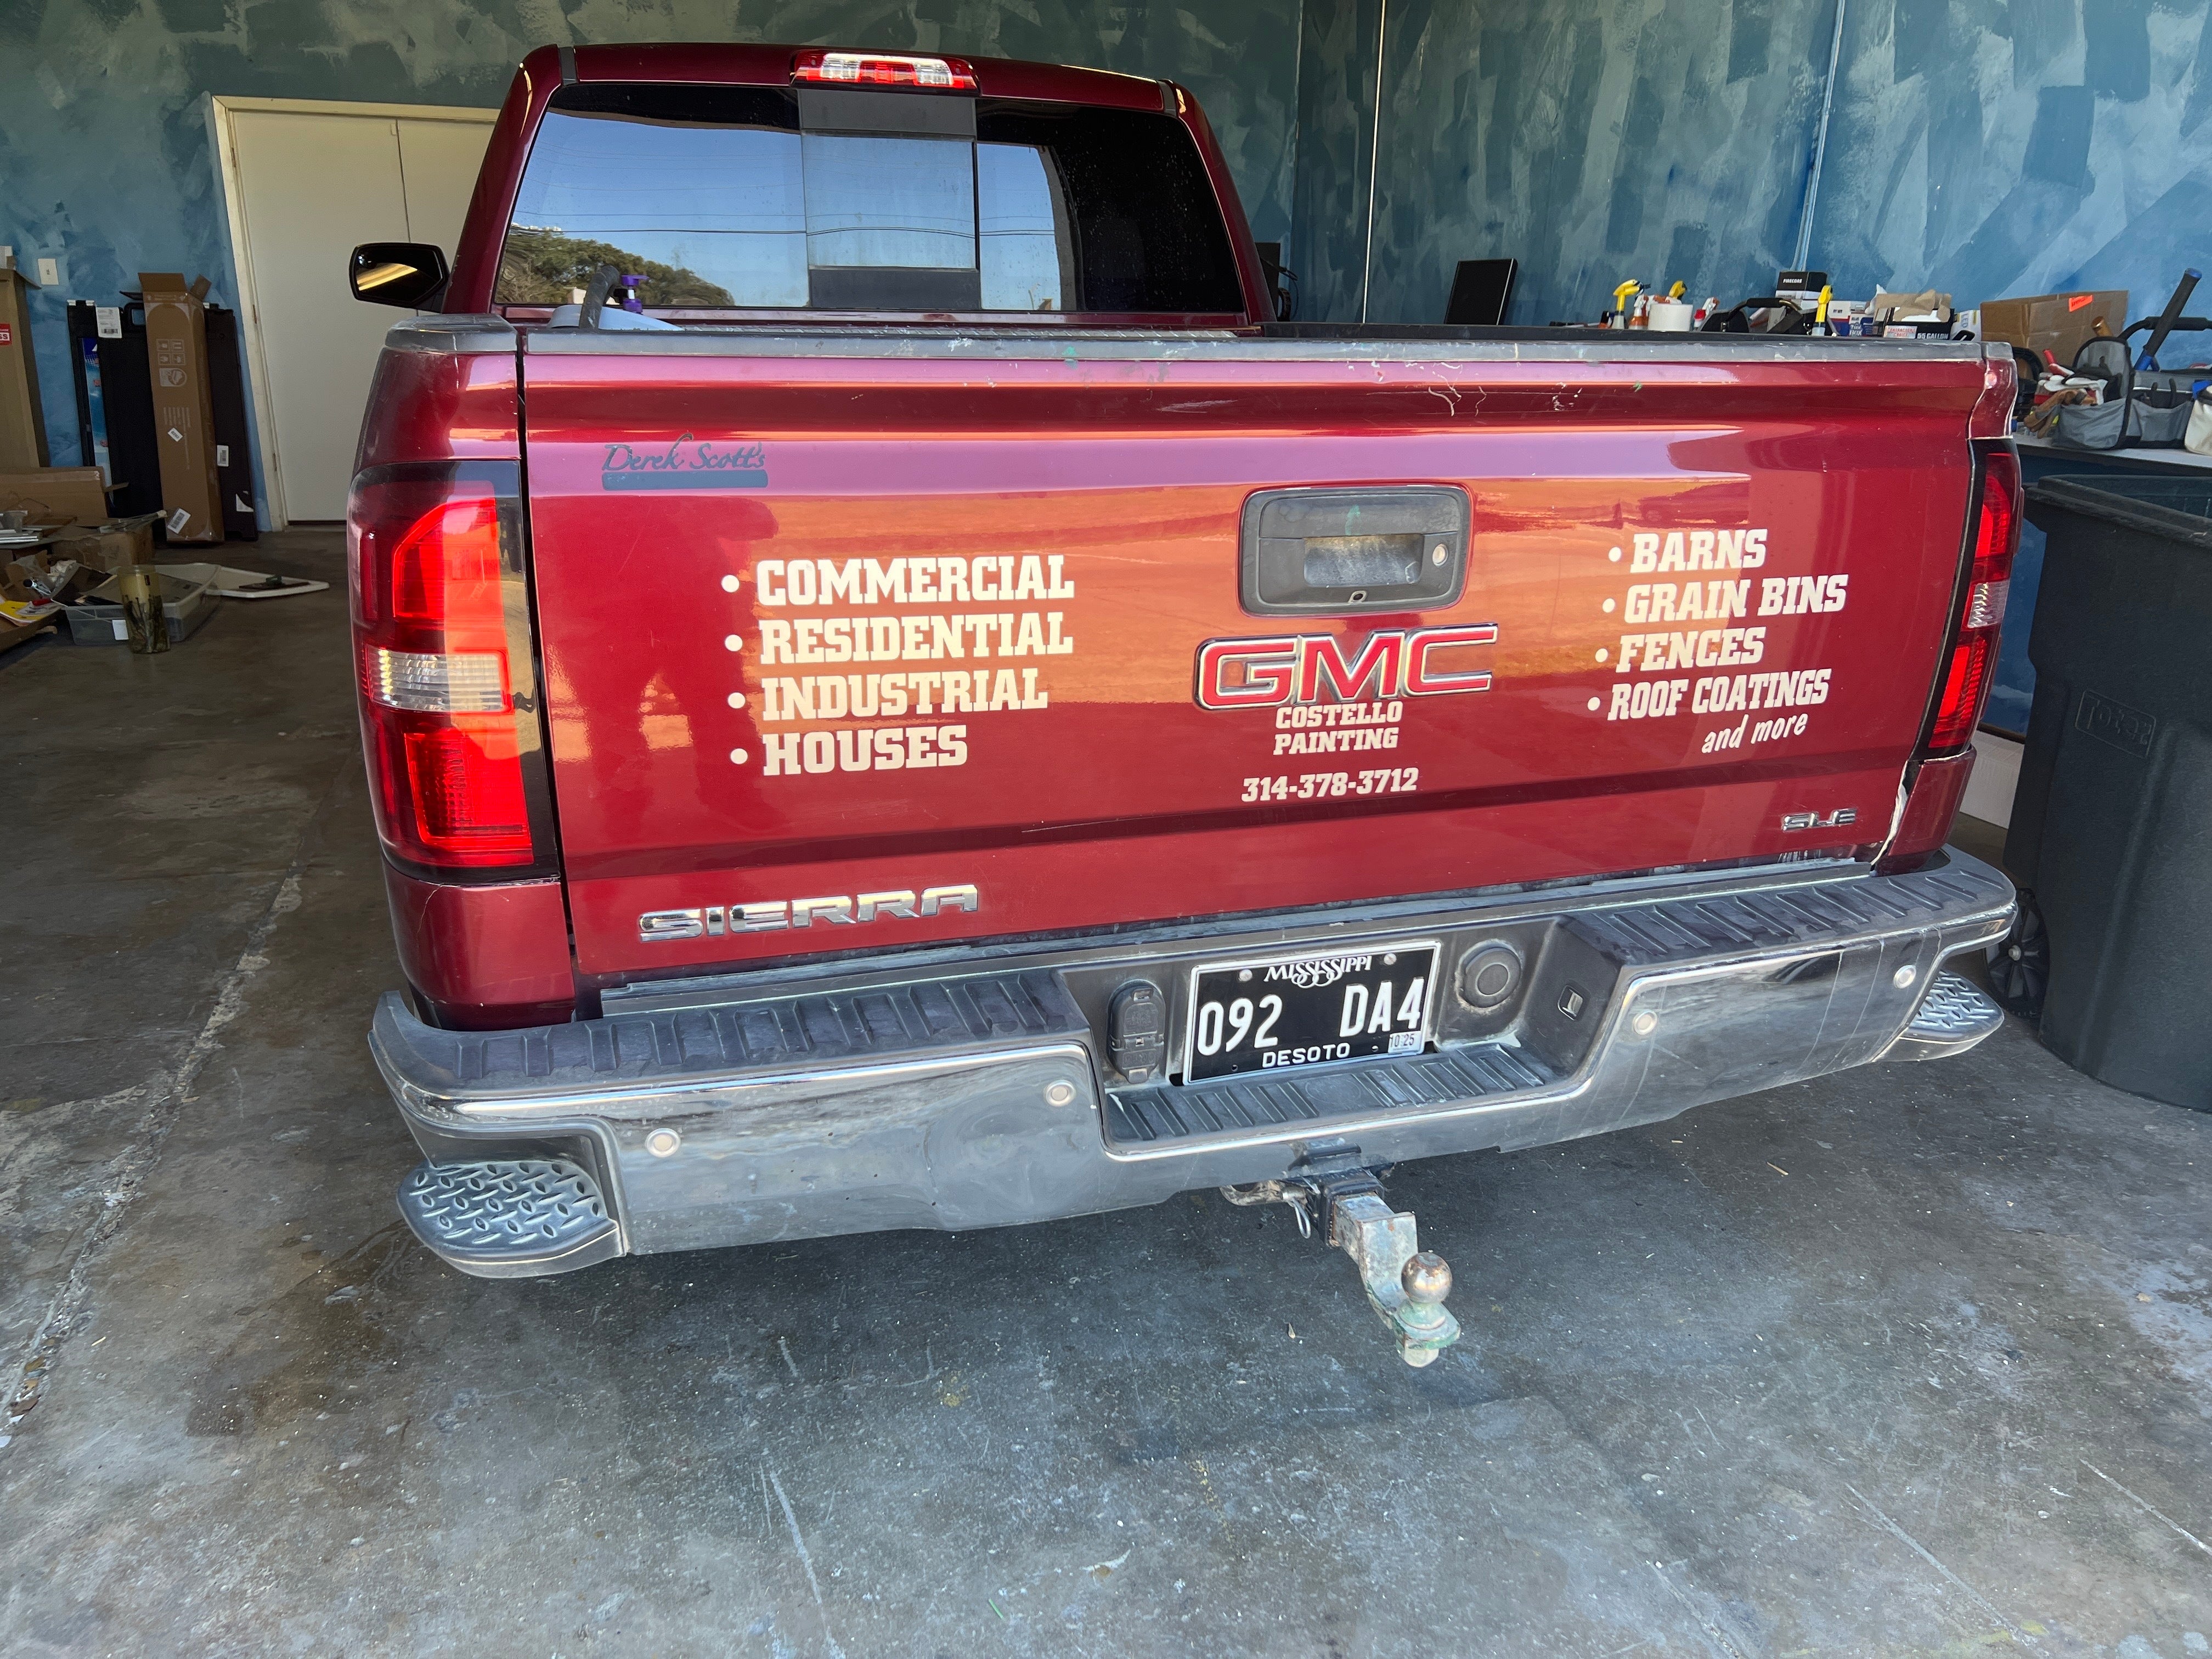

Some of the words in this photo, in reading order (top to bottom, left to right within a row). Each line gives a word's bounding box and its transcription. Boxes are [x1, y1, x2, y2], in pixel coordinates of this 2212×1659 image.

[601, 433, 693, 470] Derek
[690, 442, 766, 470] Scott's
[1629, 528, 1768, 574] BARNS
[756, 554, 1075, 606] COMMERCIAL
[1624, 579, 1751, 624] GRAIN
[1757, 574, 1849, 617] BINS
[758, 612, 1074, 664] RESIDENTIAL
[1615, 627, 1767, 673] FENCES
[1193, 622, 1498, 710] GMC
[761, 668, 1048, 720] INDUSTRIAL
[1275, 701, 1403, 729] COSTELLO
[1607, 679, 1689, 721] ROOF
[1691, 669, 1832, 714] COATINGS
[763, 725, 968, 776] HOUSES
[1273, 727, 1399, 755] PAINTING
[1701, 714, 1749, 753] and
[1750, 713, 1808, 744] more
[1241, 767, 1419, 802] 314-378-3712
[1782, 808, 1857, 831] SLE
[638, 884, 978, 942] SIERRA
[1263, 955, 1372, 989] MISSISSIPPI
[1197, 994, 1283, 1057] 092
[1339, 977, 1425, 1038] DA4
[1404, 1034, 1414, 1046] 25
[1261, 1042, 1351, 1068] DESOTO
